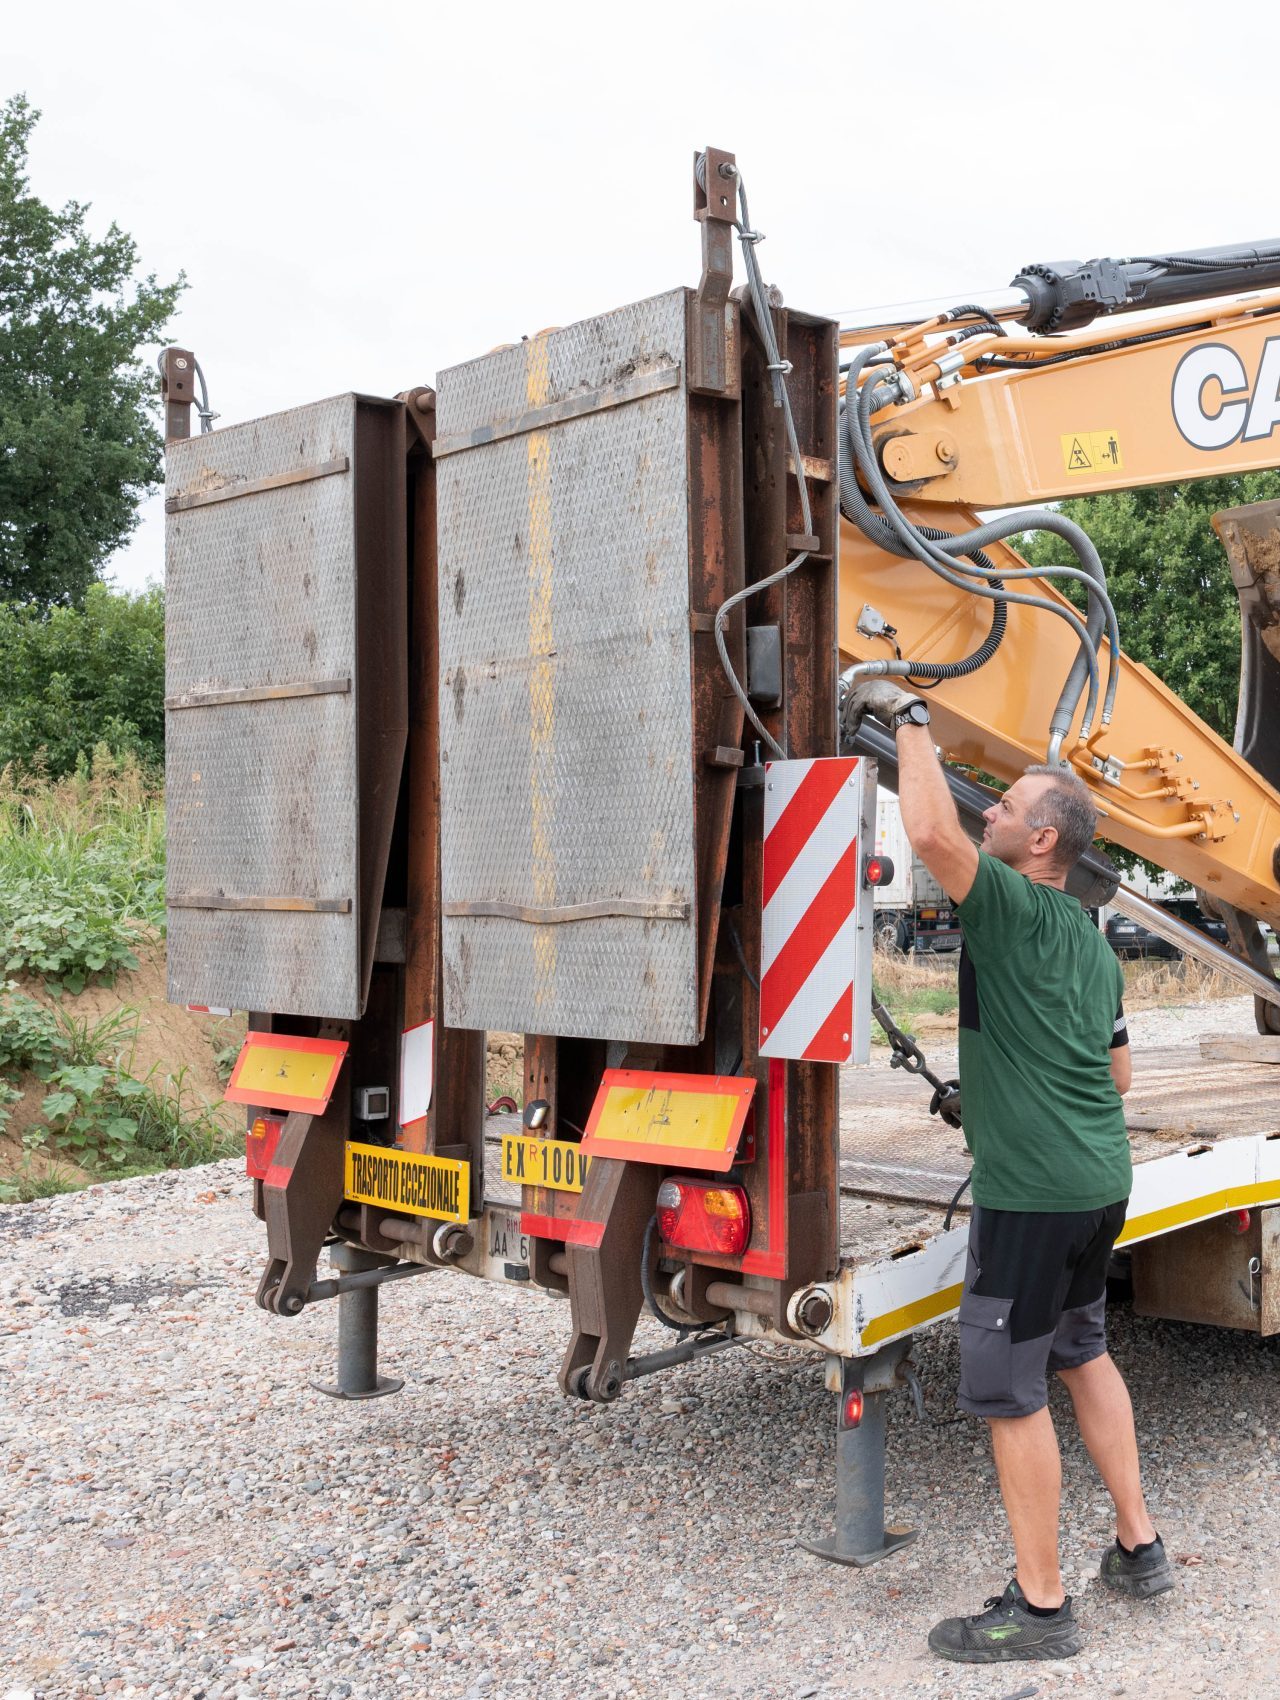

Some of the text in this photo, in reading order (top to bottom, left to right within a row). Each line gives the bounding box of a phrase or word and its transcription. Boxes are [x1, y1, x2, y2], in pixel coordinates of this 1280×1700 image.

[352, 1152, 460, 1214] TRASPORTO ECCEZIONALE
[506, 1141, 525, 1177] EX
